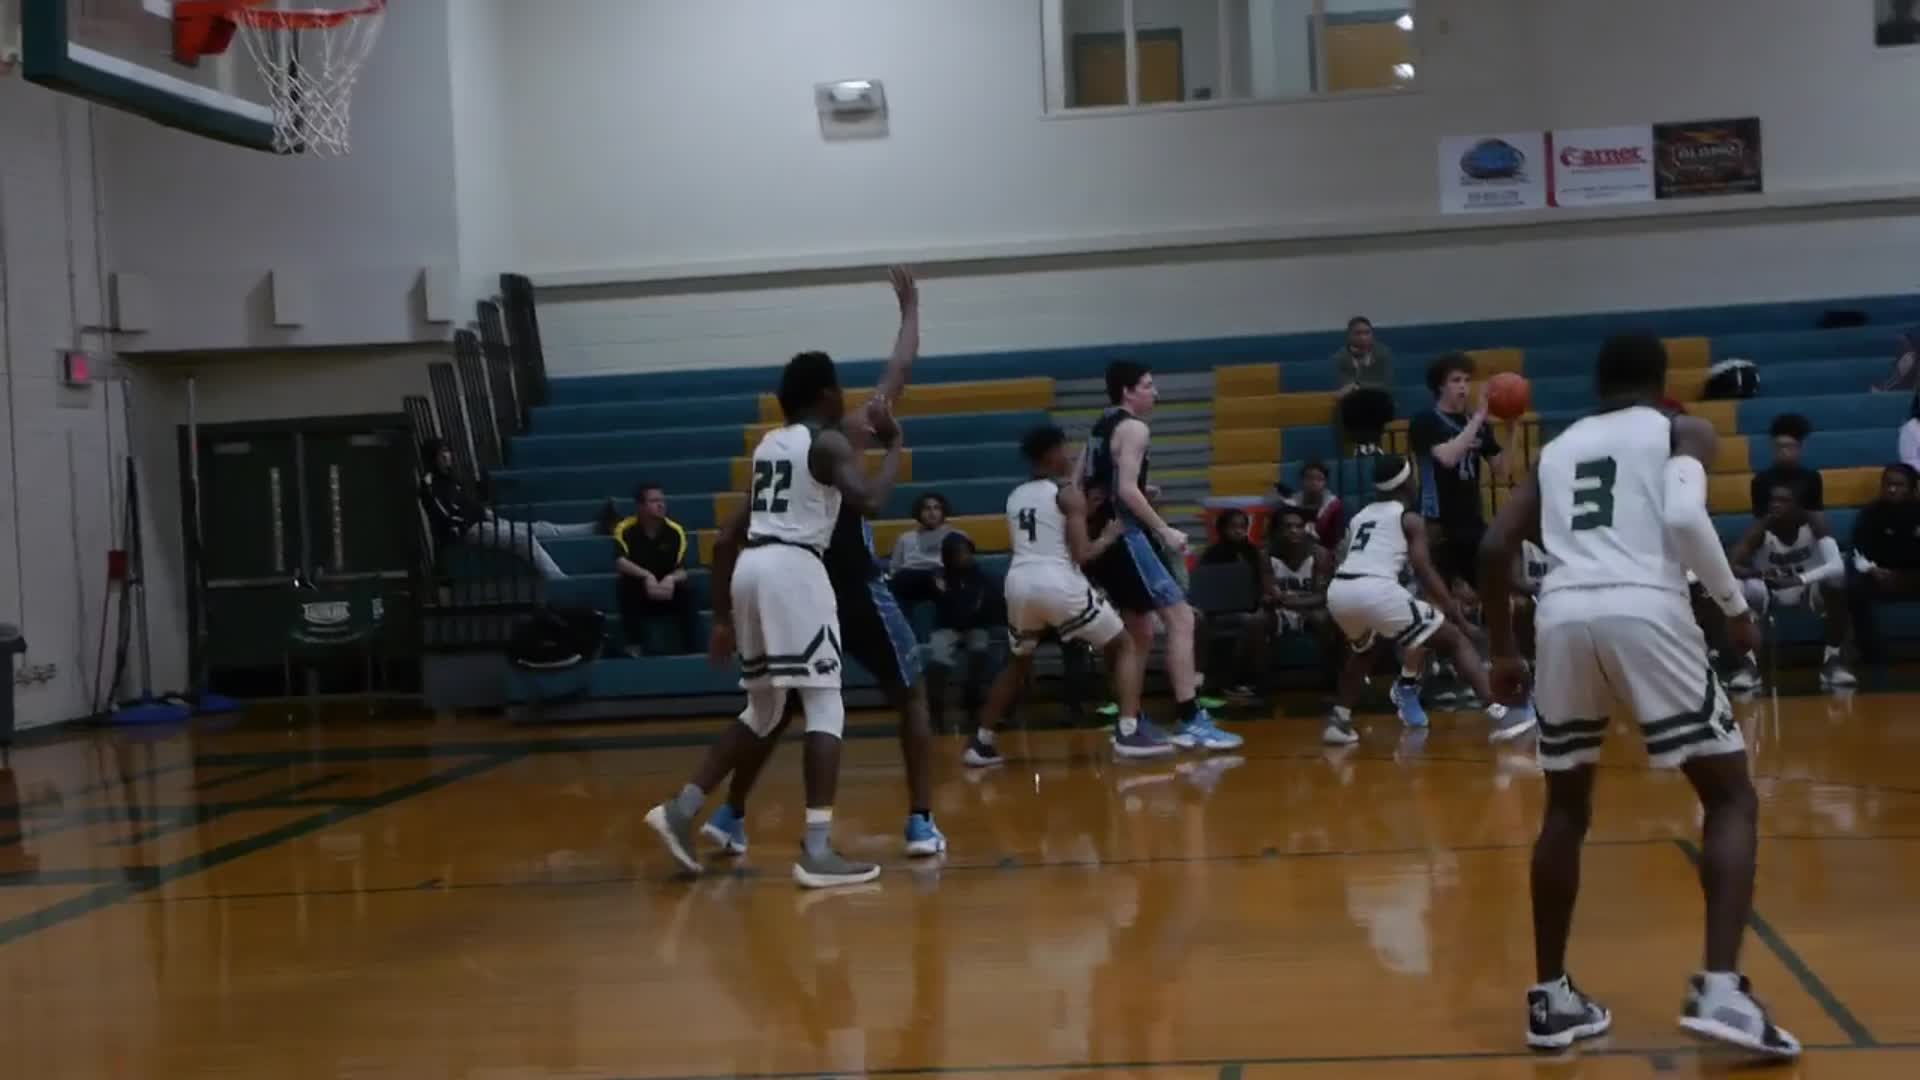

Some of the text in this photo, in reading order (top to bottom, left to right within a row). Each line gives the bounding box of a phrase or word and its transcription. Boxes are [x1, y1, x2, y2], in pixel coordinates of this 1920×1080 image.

[752, 459, 793, 513] 22
[1571, 455, 1617, 531] 3
[1019, 508, 1037, 542] 4
[1350, 520, 1377, 552] 5
